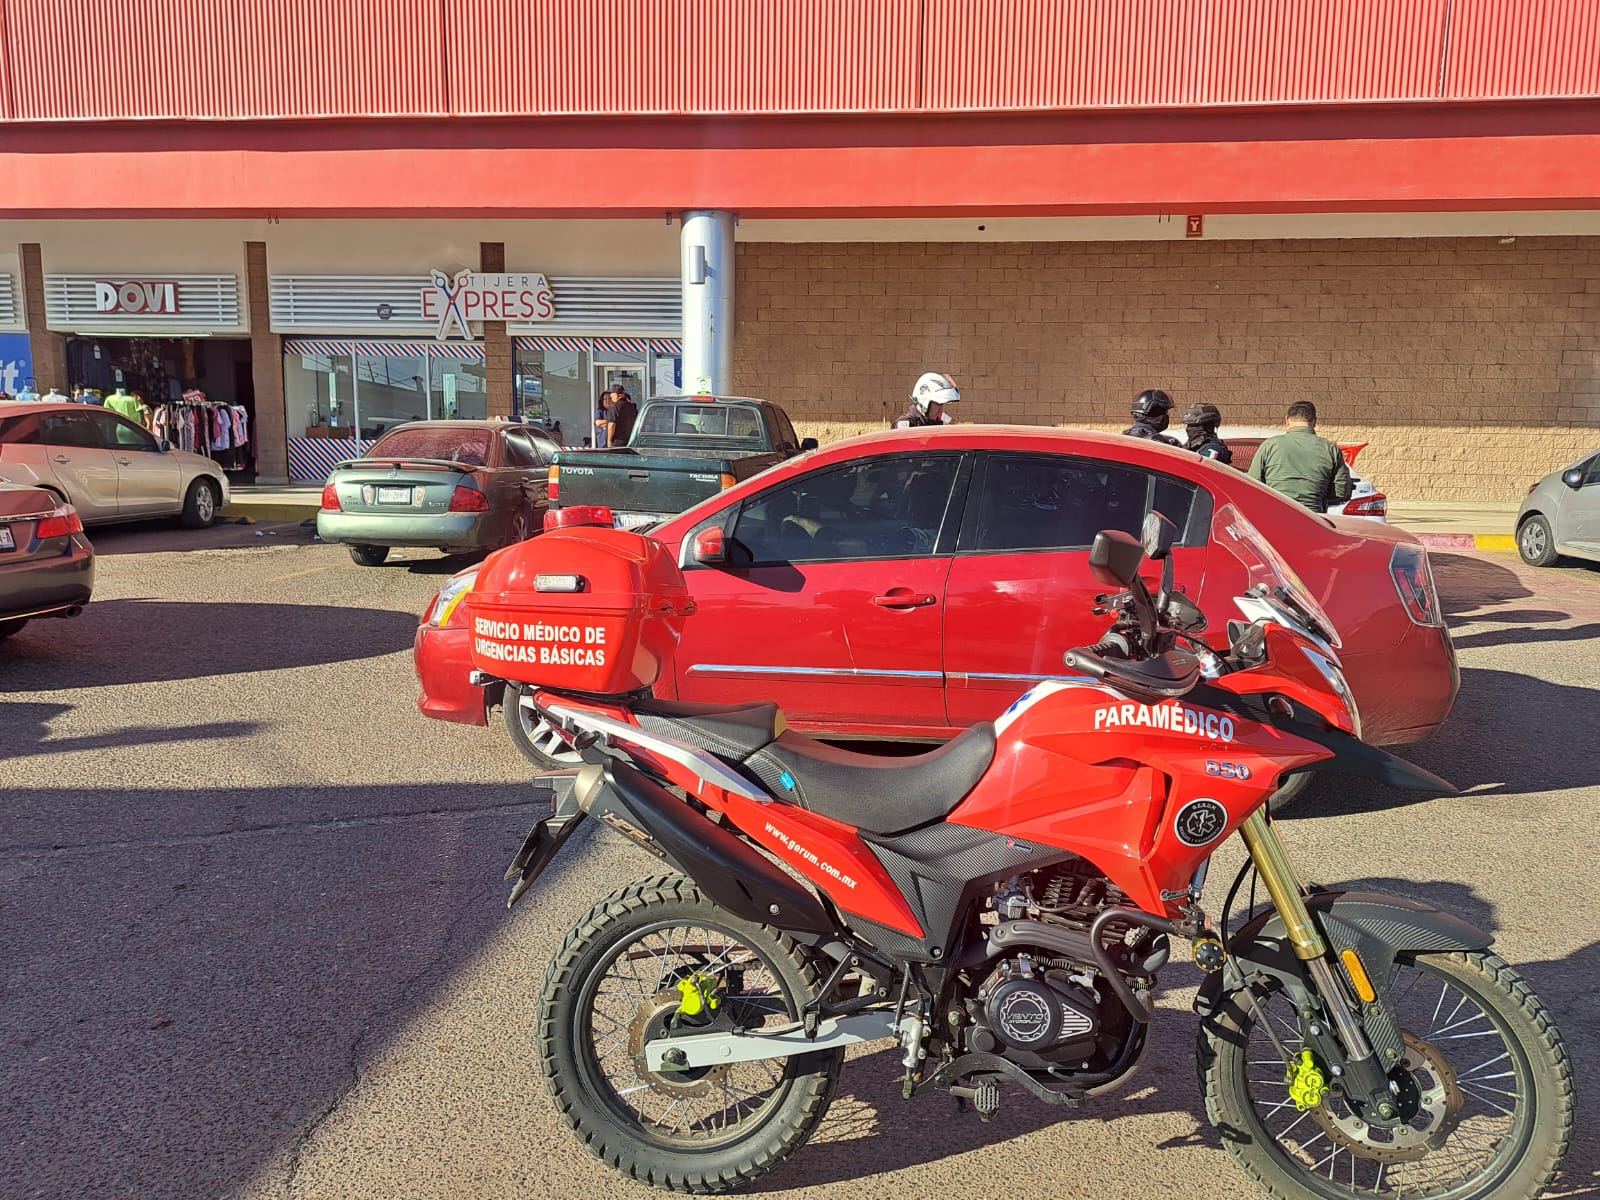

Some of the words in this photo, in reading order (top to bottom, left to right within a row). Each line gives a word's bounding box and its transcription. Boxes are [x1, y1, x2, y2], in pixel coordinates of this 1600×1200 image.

[469, 276, 546, 287] TIJERA
[95, 282, 177, 313] DOVI
[423, 288, 551, 338] EXPRESS
[561, 466, 594, 476] TOYOTA
[475, 617, 520, 641] SERVICIO
[523, 620, 581, 643] MÉDICO
[585, 626, 606, 644] DE
[475, 637, 537, 663] URGENCIAS
[540, 642, 605, 666] BÁSICAS
[1094, 702, 1234, 742] PARAMÉDICO
[1006, 1012, 1044, 1020] VENTO
